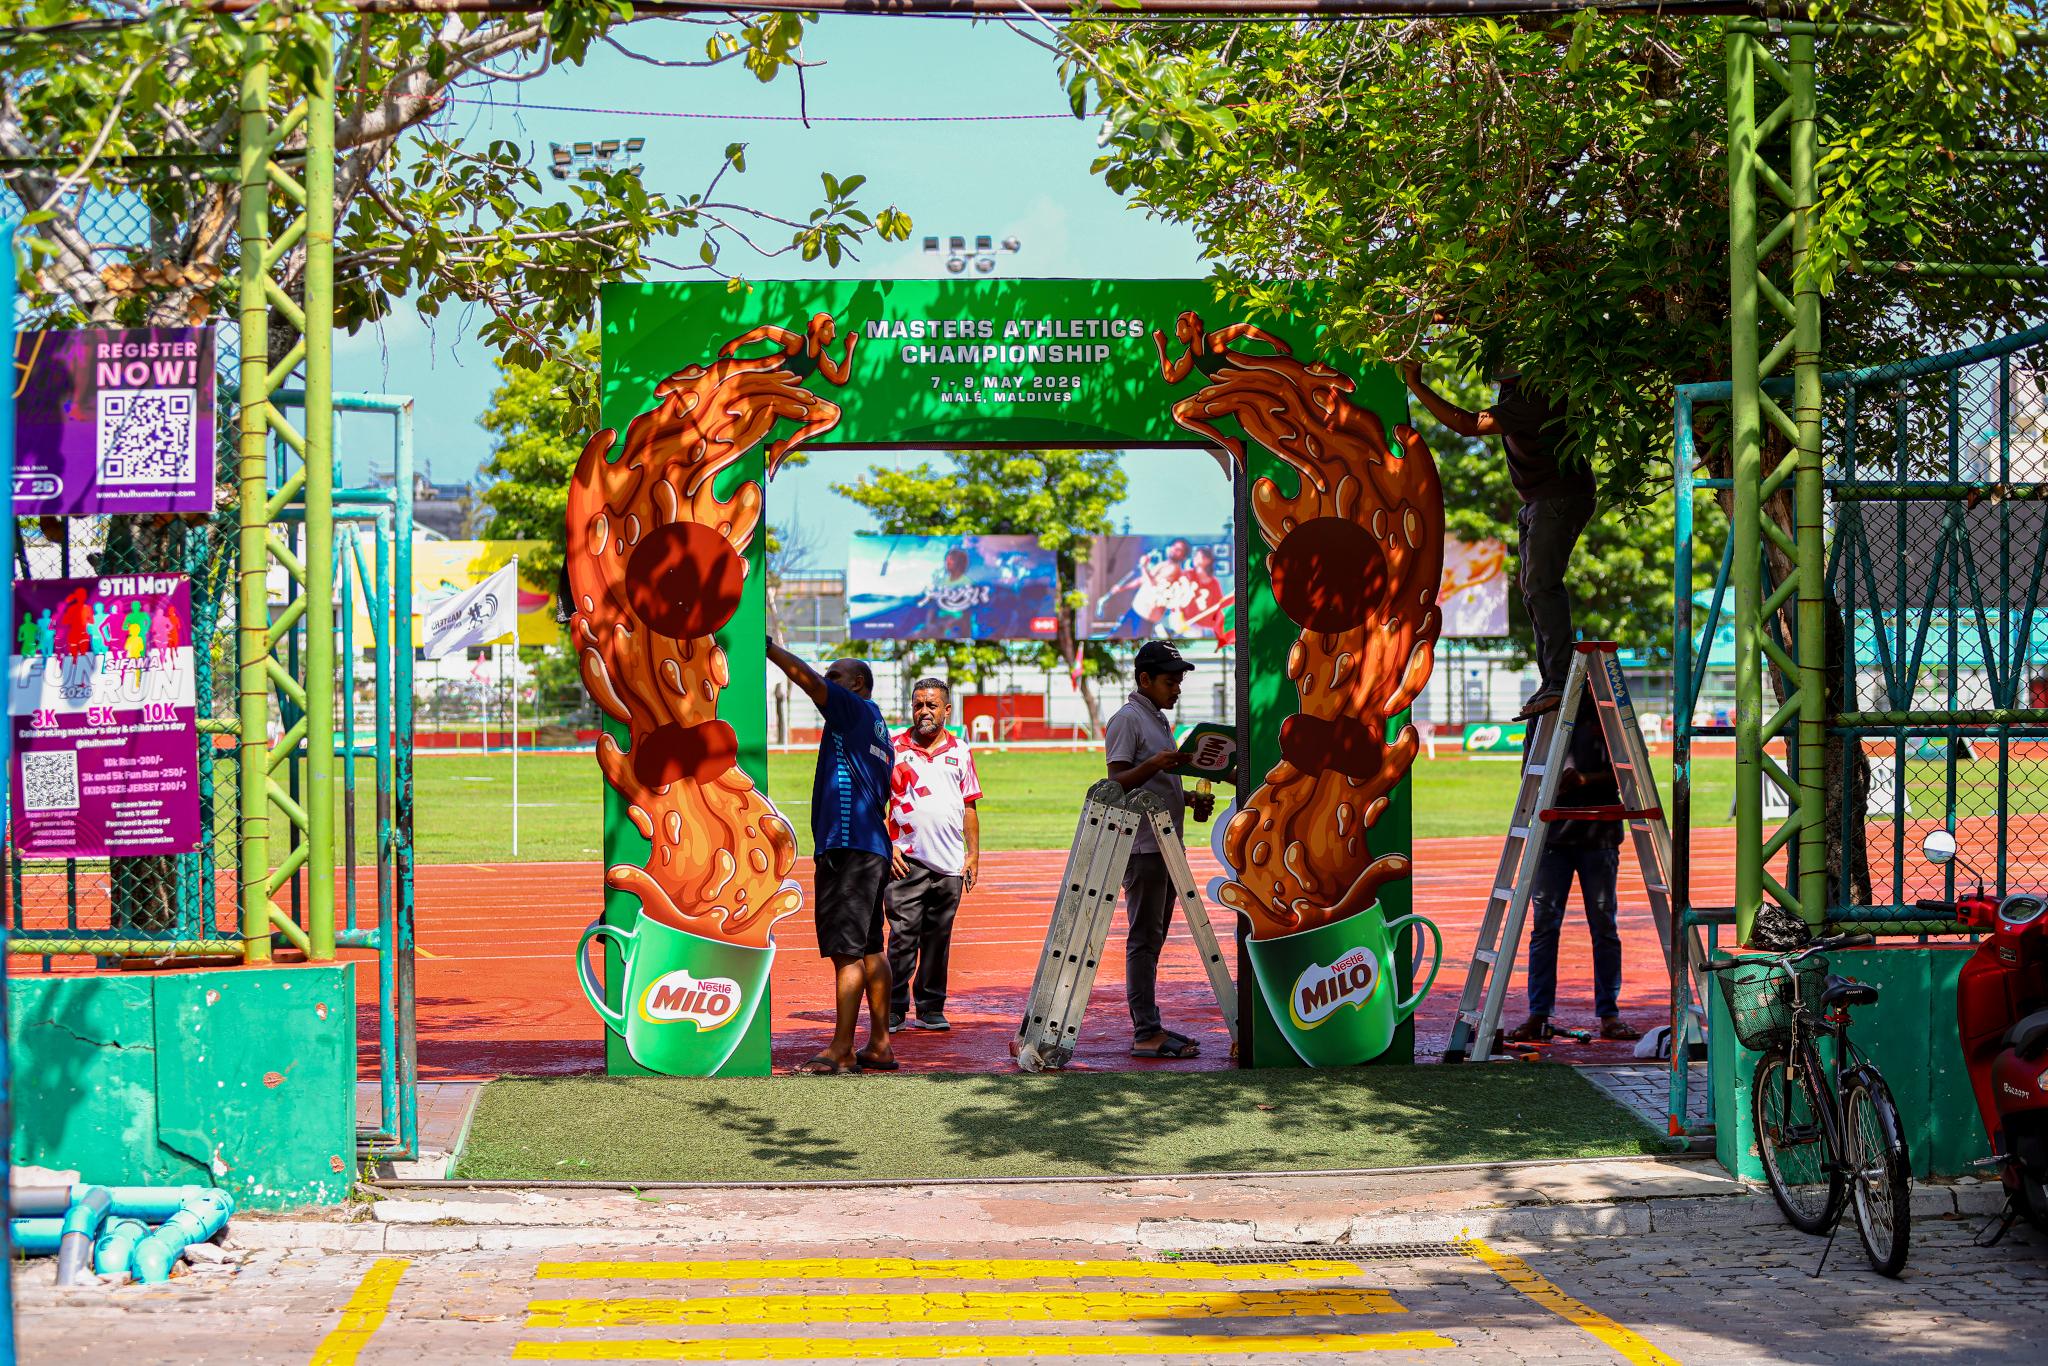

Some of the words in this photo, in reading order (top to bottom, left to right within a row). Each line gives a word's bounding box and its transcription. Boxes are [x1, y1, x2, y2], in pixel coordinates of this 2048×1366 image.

[866, 319, 994, 339] MASTERS
[1003, 319, 1144, 339] ATHLETICS
[97, 342, 198, 359] REGISTER
[901, 344, 1110, 364] CHAMPIONSHIP
[97, 360, 198, 387] NOW!
[930, 376, 940, 389] 7
[964, 376, 974, 389] 9
[983, 376, 1024, 389] MAY
[1033, 376, 1082, 389] 2026
[941, 391, 987, 404] MALÉ,
[994, 391, 1073, 402] MALDIVES
[99, 576, 137, 597] 9TH
[138, 575, 180, 596] May
[18, 653, 99, 689] FUN
[105, 656, 161, 671] SIFAMA
[59, 686, 93, 700] 2026
[93, 668, 185, 704] RUN
[30, 708, 59, 729] 3K
[86, 705, 118, 726] 5K
[143, 702, 179, 723] 10K
[119, 756, 137, 767] Run
[1197, 737, 1228, 767] MILO
[124, 769, 141, 780] Fun
[142, 768, 160, 779] Run
[127, 782, 159, 794] JERSEY
[1301, 963, 1372, 1015] MILO
[652, 985, 731, 1016] MILO
